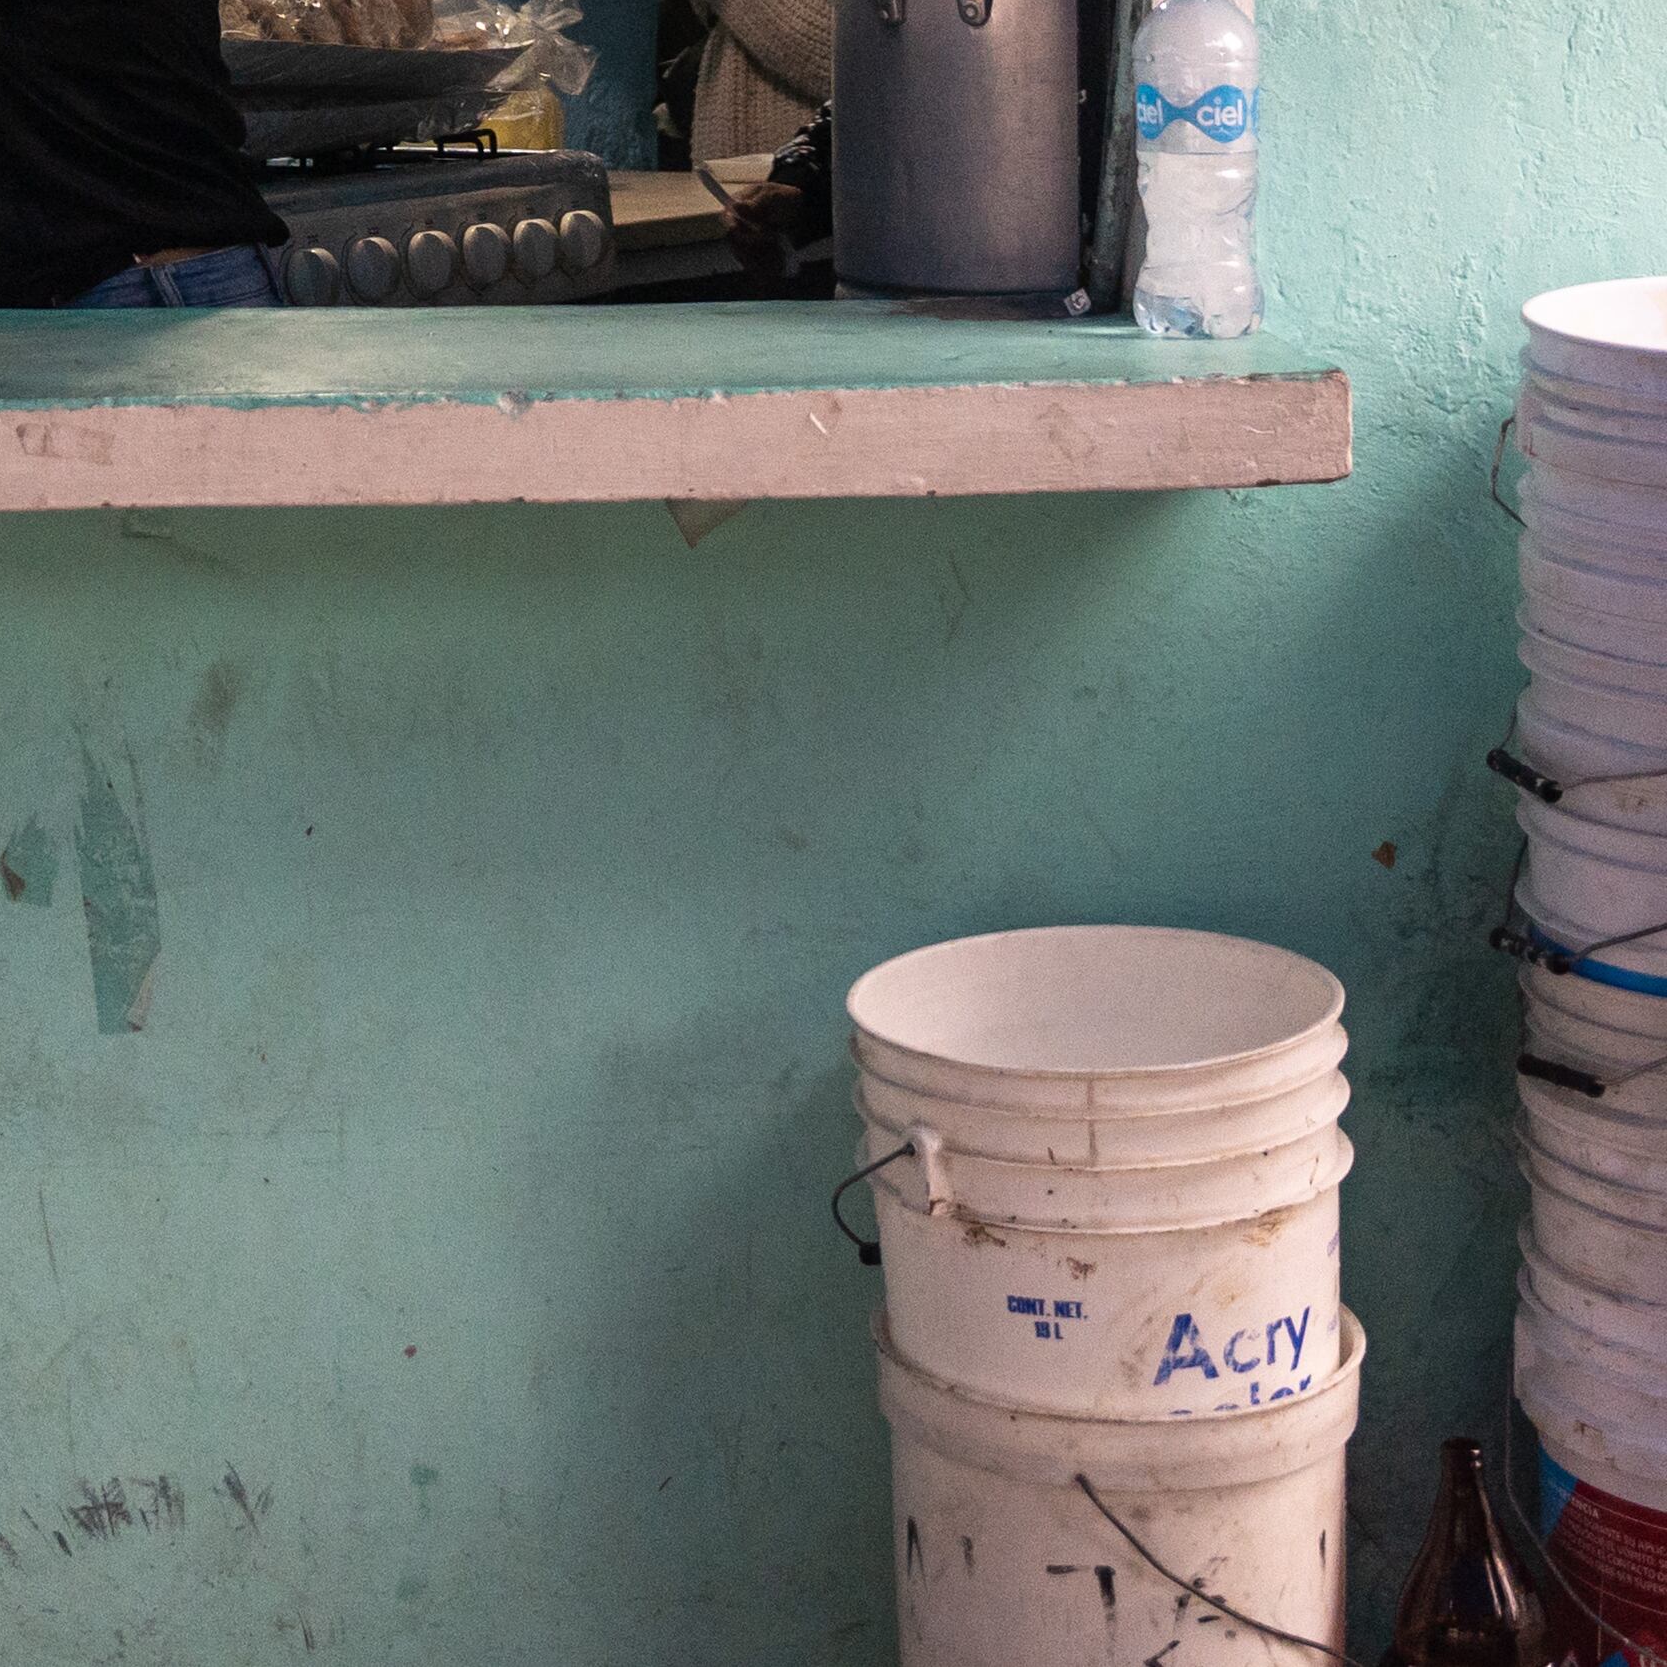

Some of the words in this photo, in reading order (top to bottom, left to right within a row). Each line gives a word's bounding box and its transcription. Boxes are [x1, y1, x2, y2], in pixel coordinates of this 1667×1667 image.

[1195, 95, 1244, 127] ciel
[1007, 1294, 1052, 1317] CONT.
[1052, 1299, 1089, 1320] NET.
[1054, 1321, 1064, 1340] L
[1152, 1305, 1312, 1387] Acry
